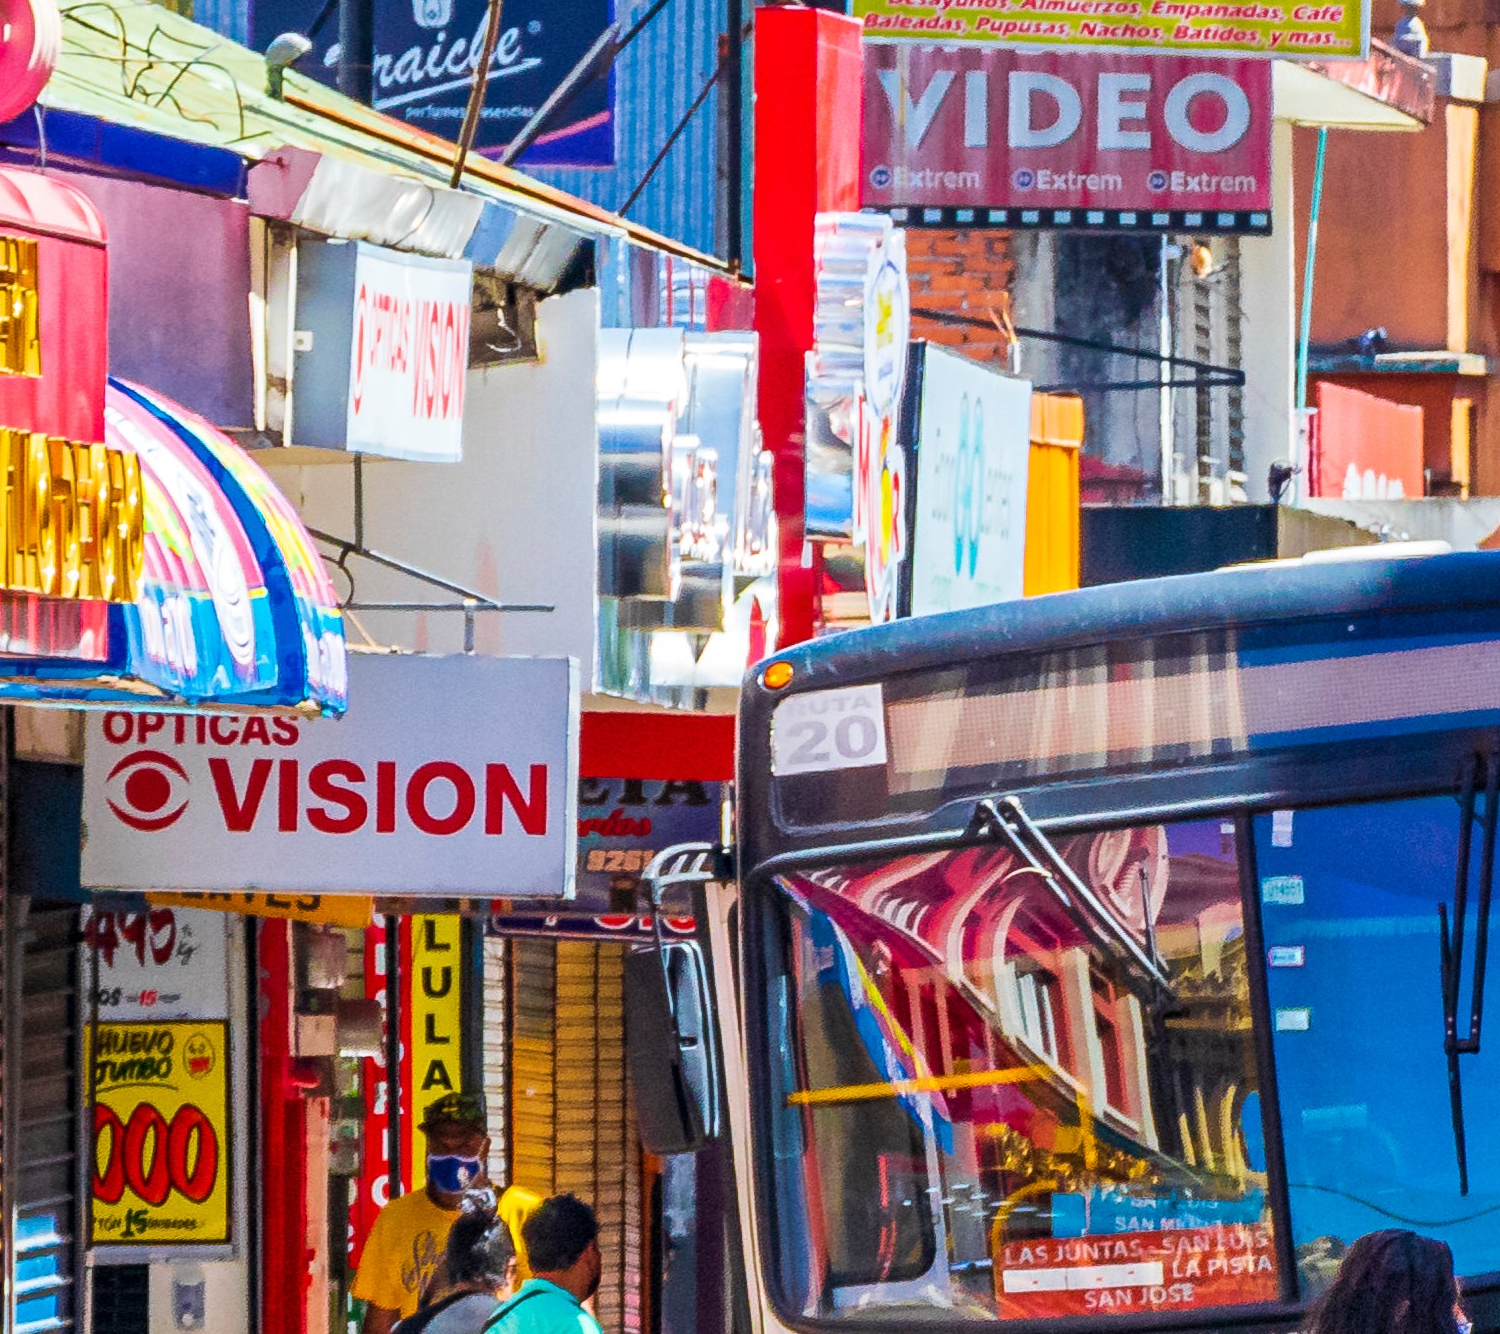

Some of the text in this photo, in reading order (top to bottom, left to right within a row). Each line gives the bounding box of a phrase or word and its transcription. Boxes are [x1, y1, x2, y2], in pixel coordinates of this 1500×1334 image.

[1293, 4, 1343, 23] Café
[323, 9, 521, 87] raiche
[877, 70, 1251, 154] VIDEO
[894, 168, 981, 192] Extrem
[1037, 168, 1123, 192] Extrem
[1170, 170, 1256, 193] Extrem
[103, 711, 299, 746] OPTICAS
[786, 715, 878, 765] 20
[208, 758, 548, 836] VISION
[98, 1028, 174, 1056] HUEVO
[1005, 1245, 1048, 1266] LAS
[1054, 1238, 1142, 1263] JUNTAS
[1162, 1233, 1210, 1255] SAN
[1172, 1254, 1274, 1279] LA PISTA
[1085, 1289, 1132, 1309] SAN
